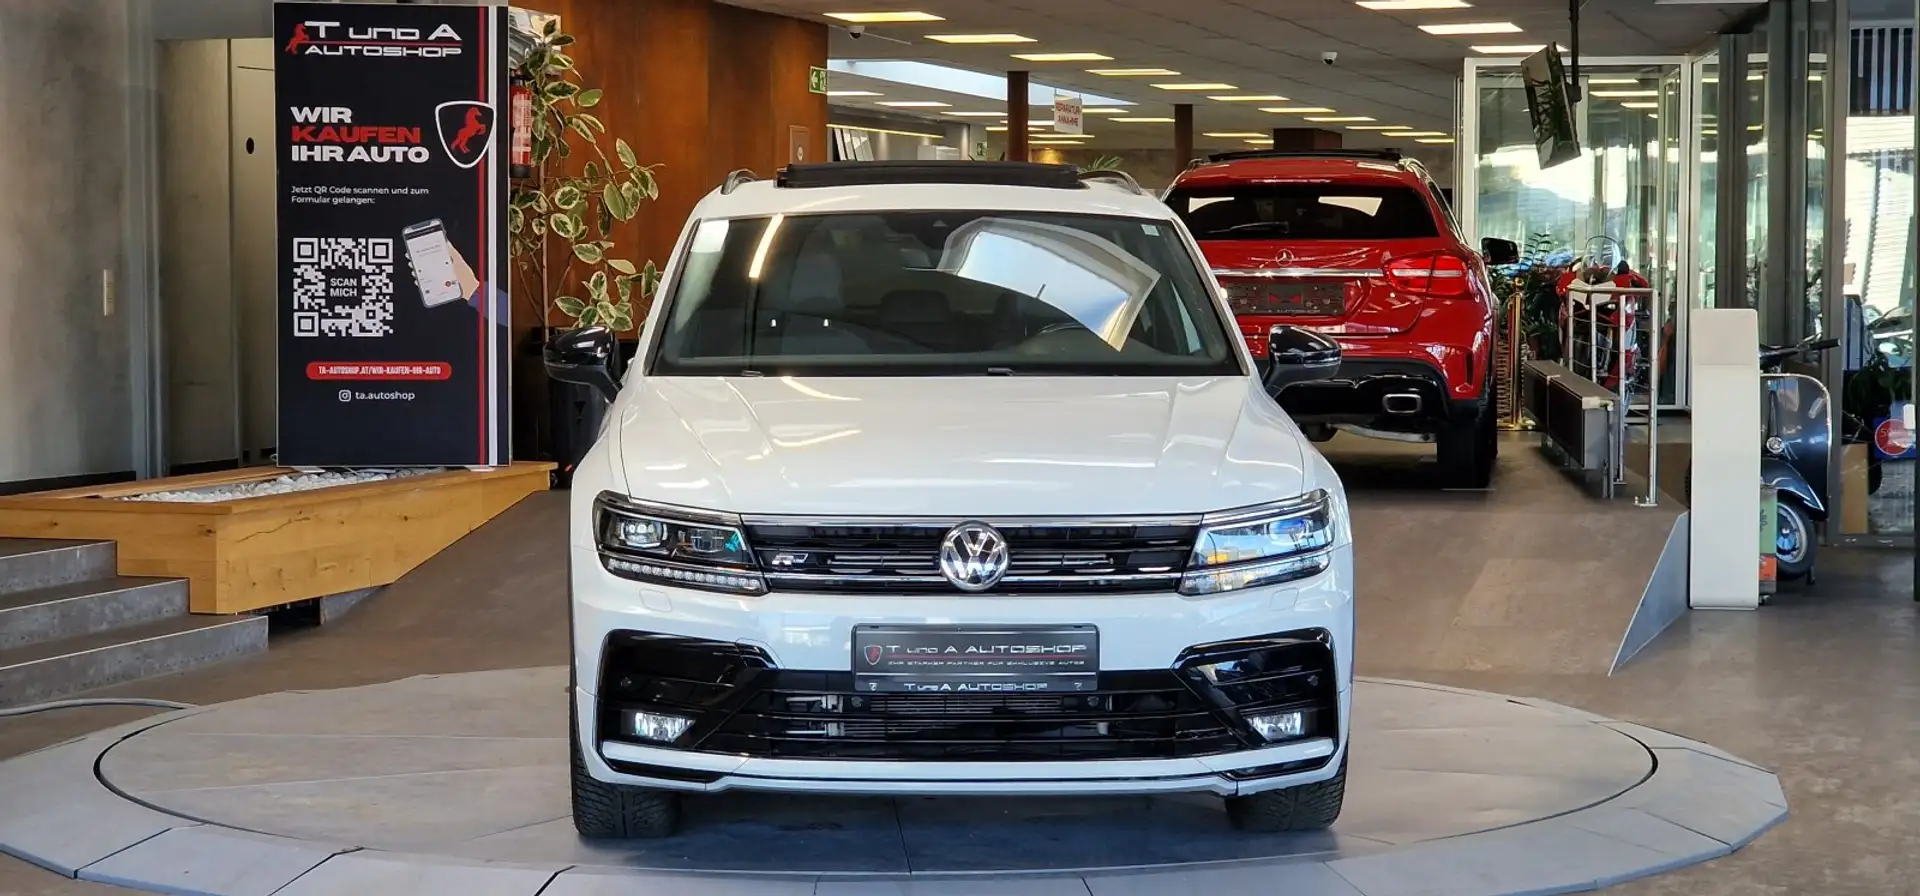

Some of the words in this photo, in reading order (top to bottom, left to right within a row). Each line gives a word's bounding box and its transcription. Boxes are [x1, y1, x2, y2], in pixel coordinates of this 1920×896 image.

[304, 20, 340, 38] T
[428, 23, 462, 41] A
[304, 45, 462, 58] AUTOSHOP
[290, 106, 352, 124] WIR
[291, 125, 421, 144] KAUFEN
[291, 145, 344, 162] IHR
[346, 146, 430, 163] AUTO
[291, 185, 313, 194] Jetzt
[313, 186, 328, 195] QR
[329, 186, 352, 194] Code
[353, 187, 390, 195] scannen
[391, 187, 409, 195] und
[291, 195, 331, 203] Formular
[330, 278, 358, 288] SCAN
[330, 287, 358, 297] MICH
[355, 391, 416, 401] ta.autoshop
[886, 645, 900, 653] T
[944, 645, 958, 653] A
[965, 644, 1087, 653] AUTOSHOP
[940, 683, 952, 691] A
[957, 683, 1048, 691] AUTOSHOP
